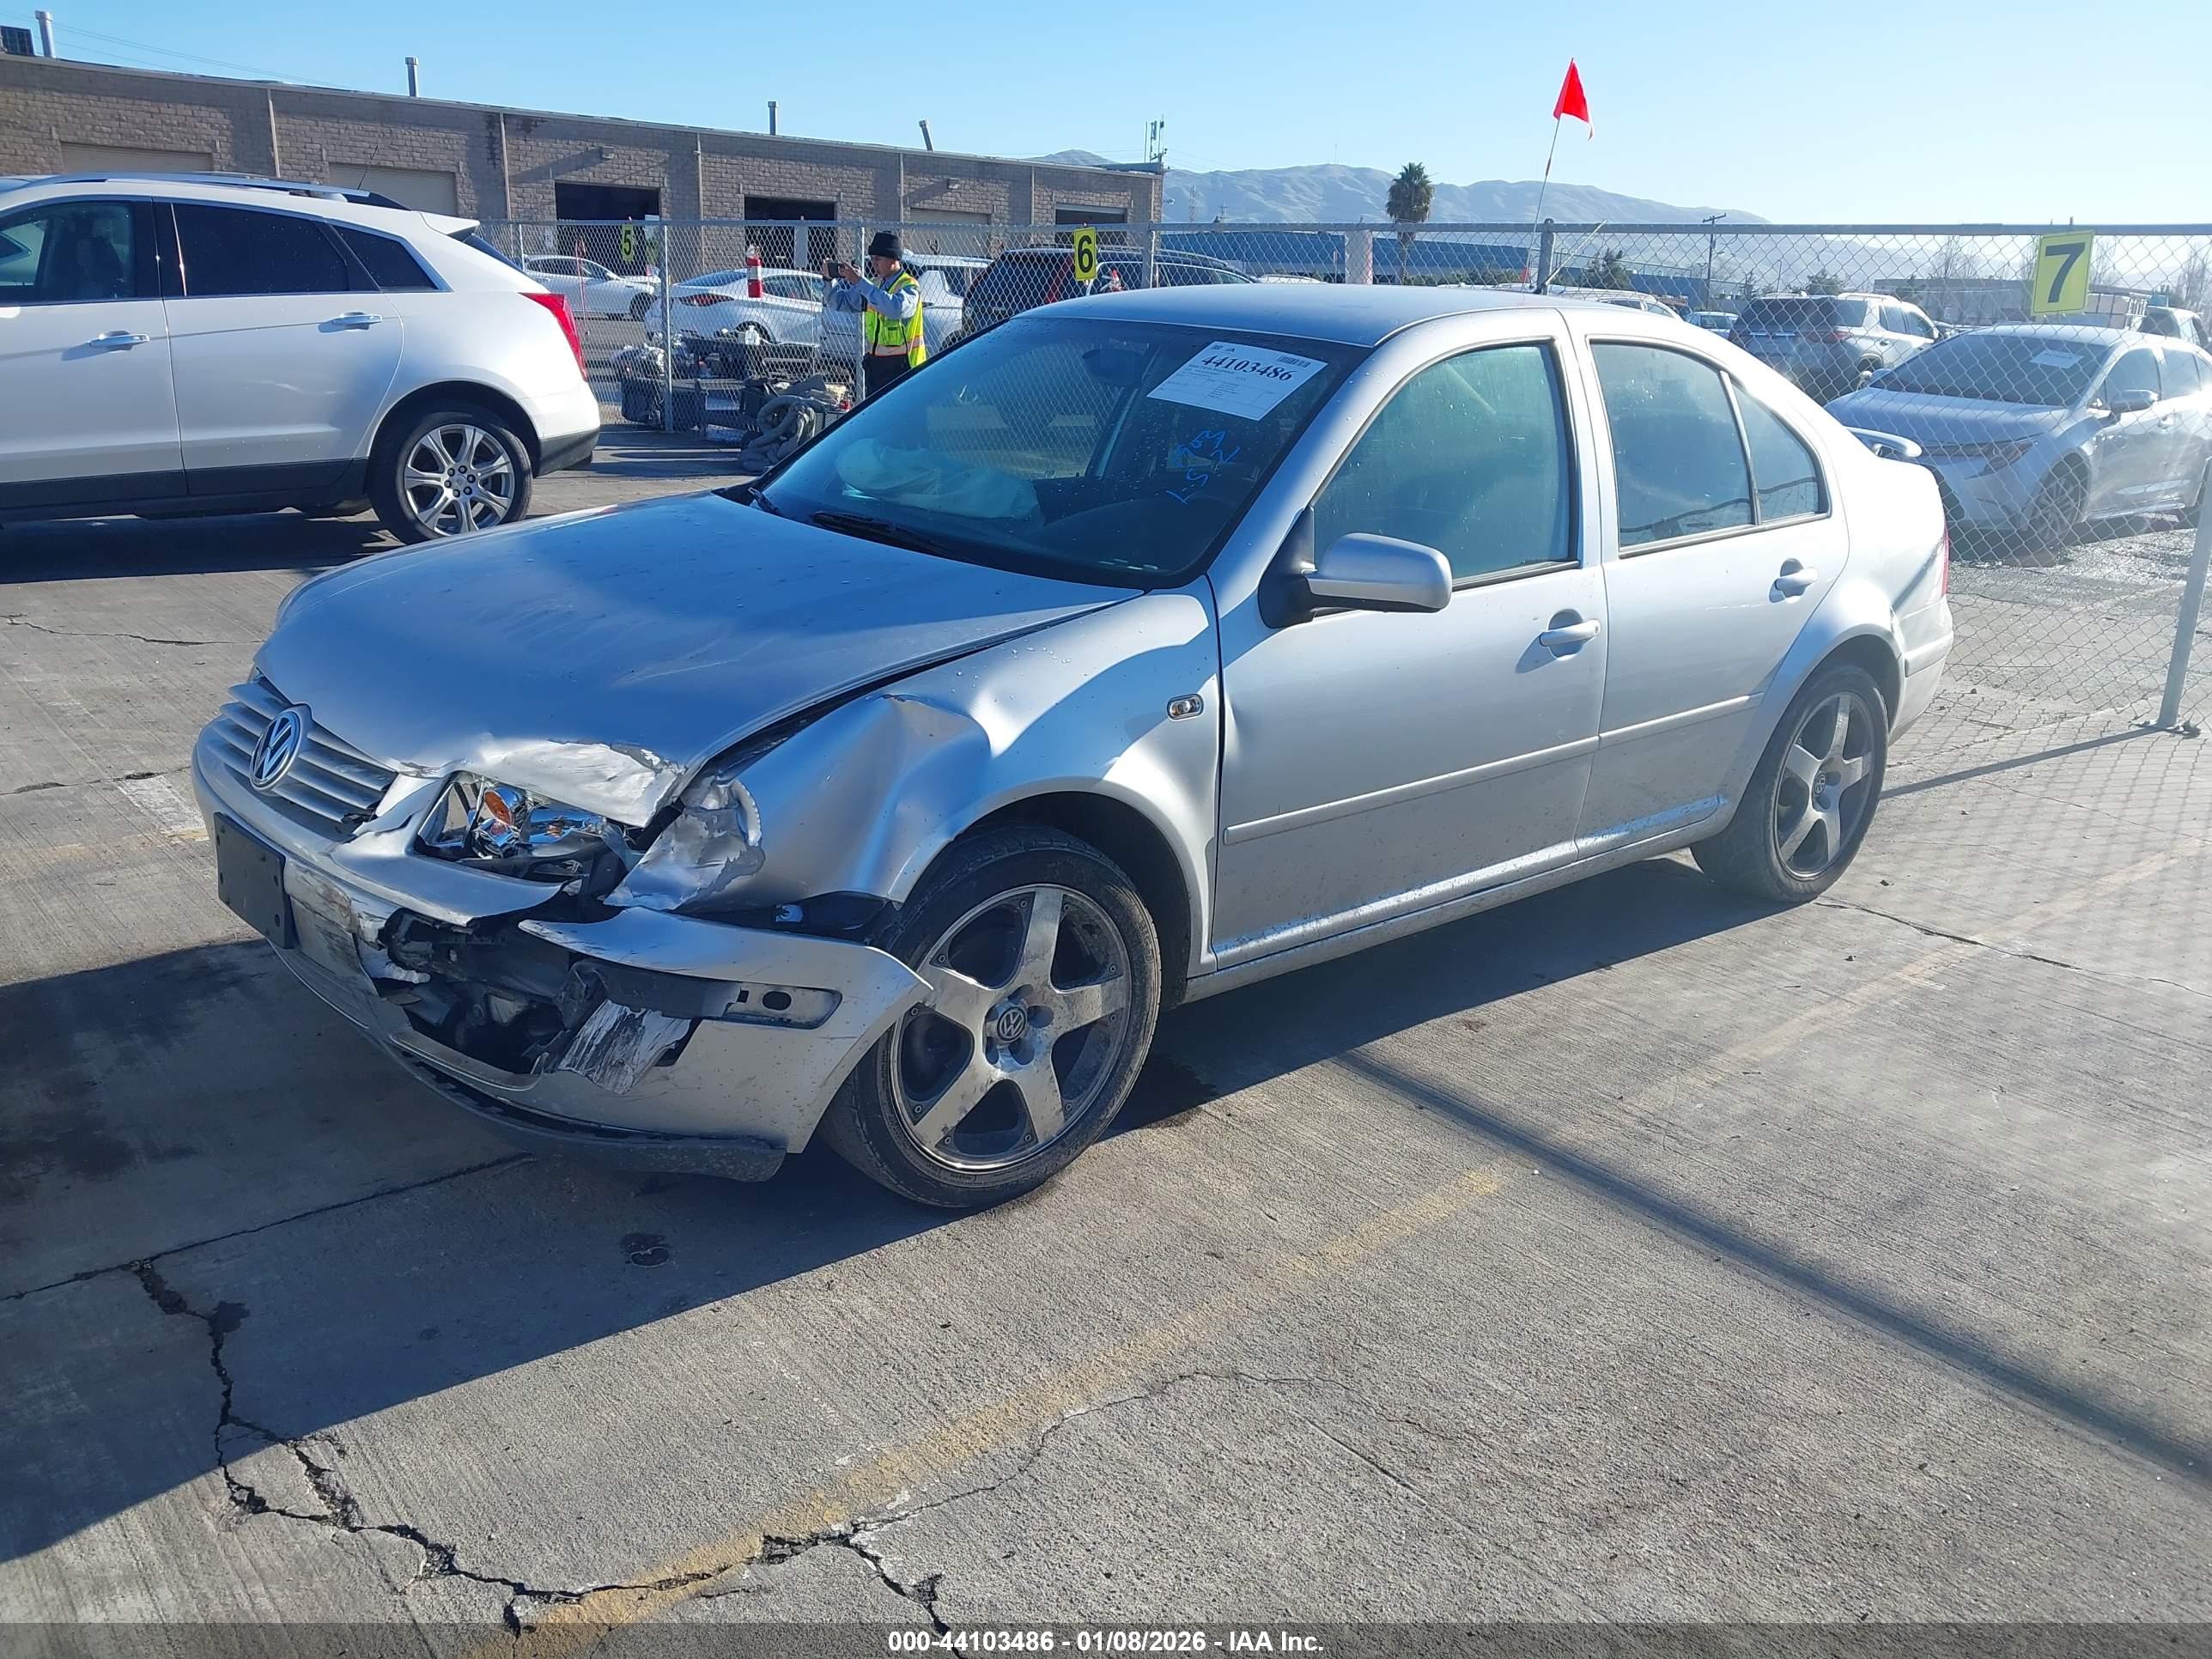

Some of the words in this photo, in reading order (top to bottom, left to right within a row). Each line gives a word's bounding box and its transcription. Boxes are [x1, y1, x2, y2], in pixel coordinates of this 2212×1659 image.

[623, 229, 632, 256] 5
[1078, 234, 1094, 273] 6
[2045, 241, 2086, 303] 7
[1201, 355, 1297, 381] 44103486
[252, 713, 296, 783] VW
[999, 1008, 1025, 1040] VW
